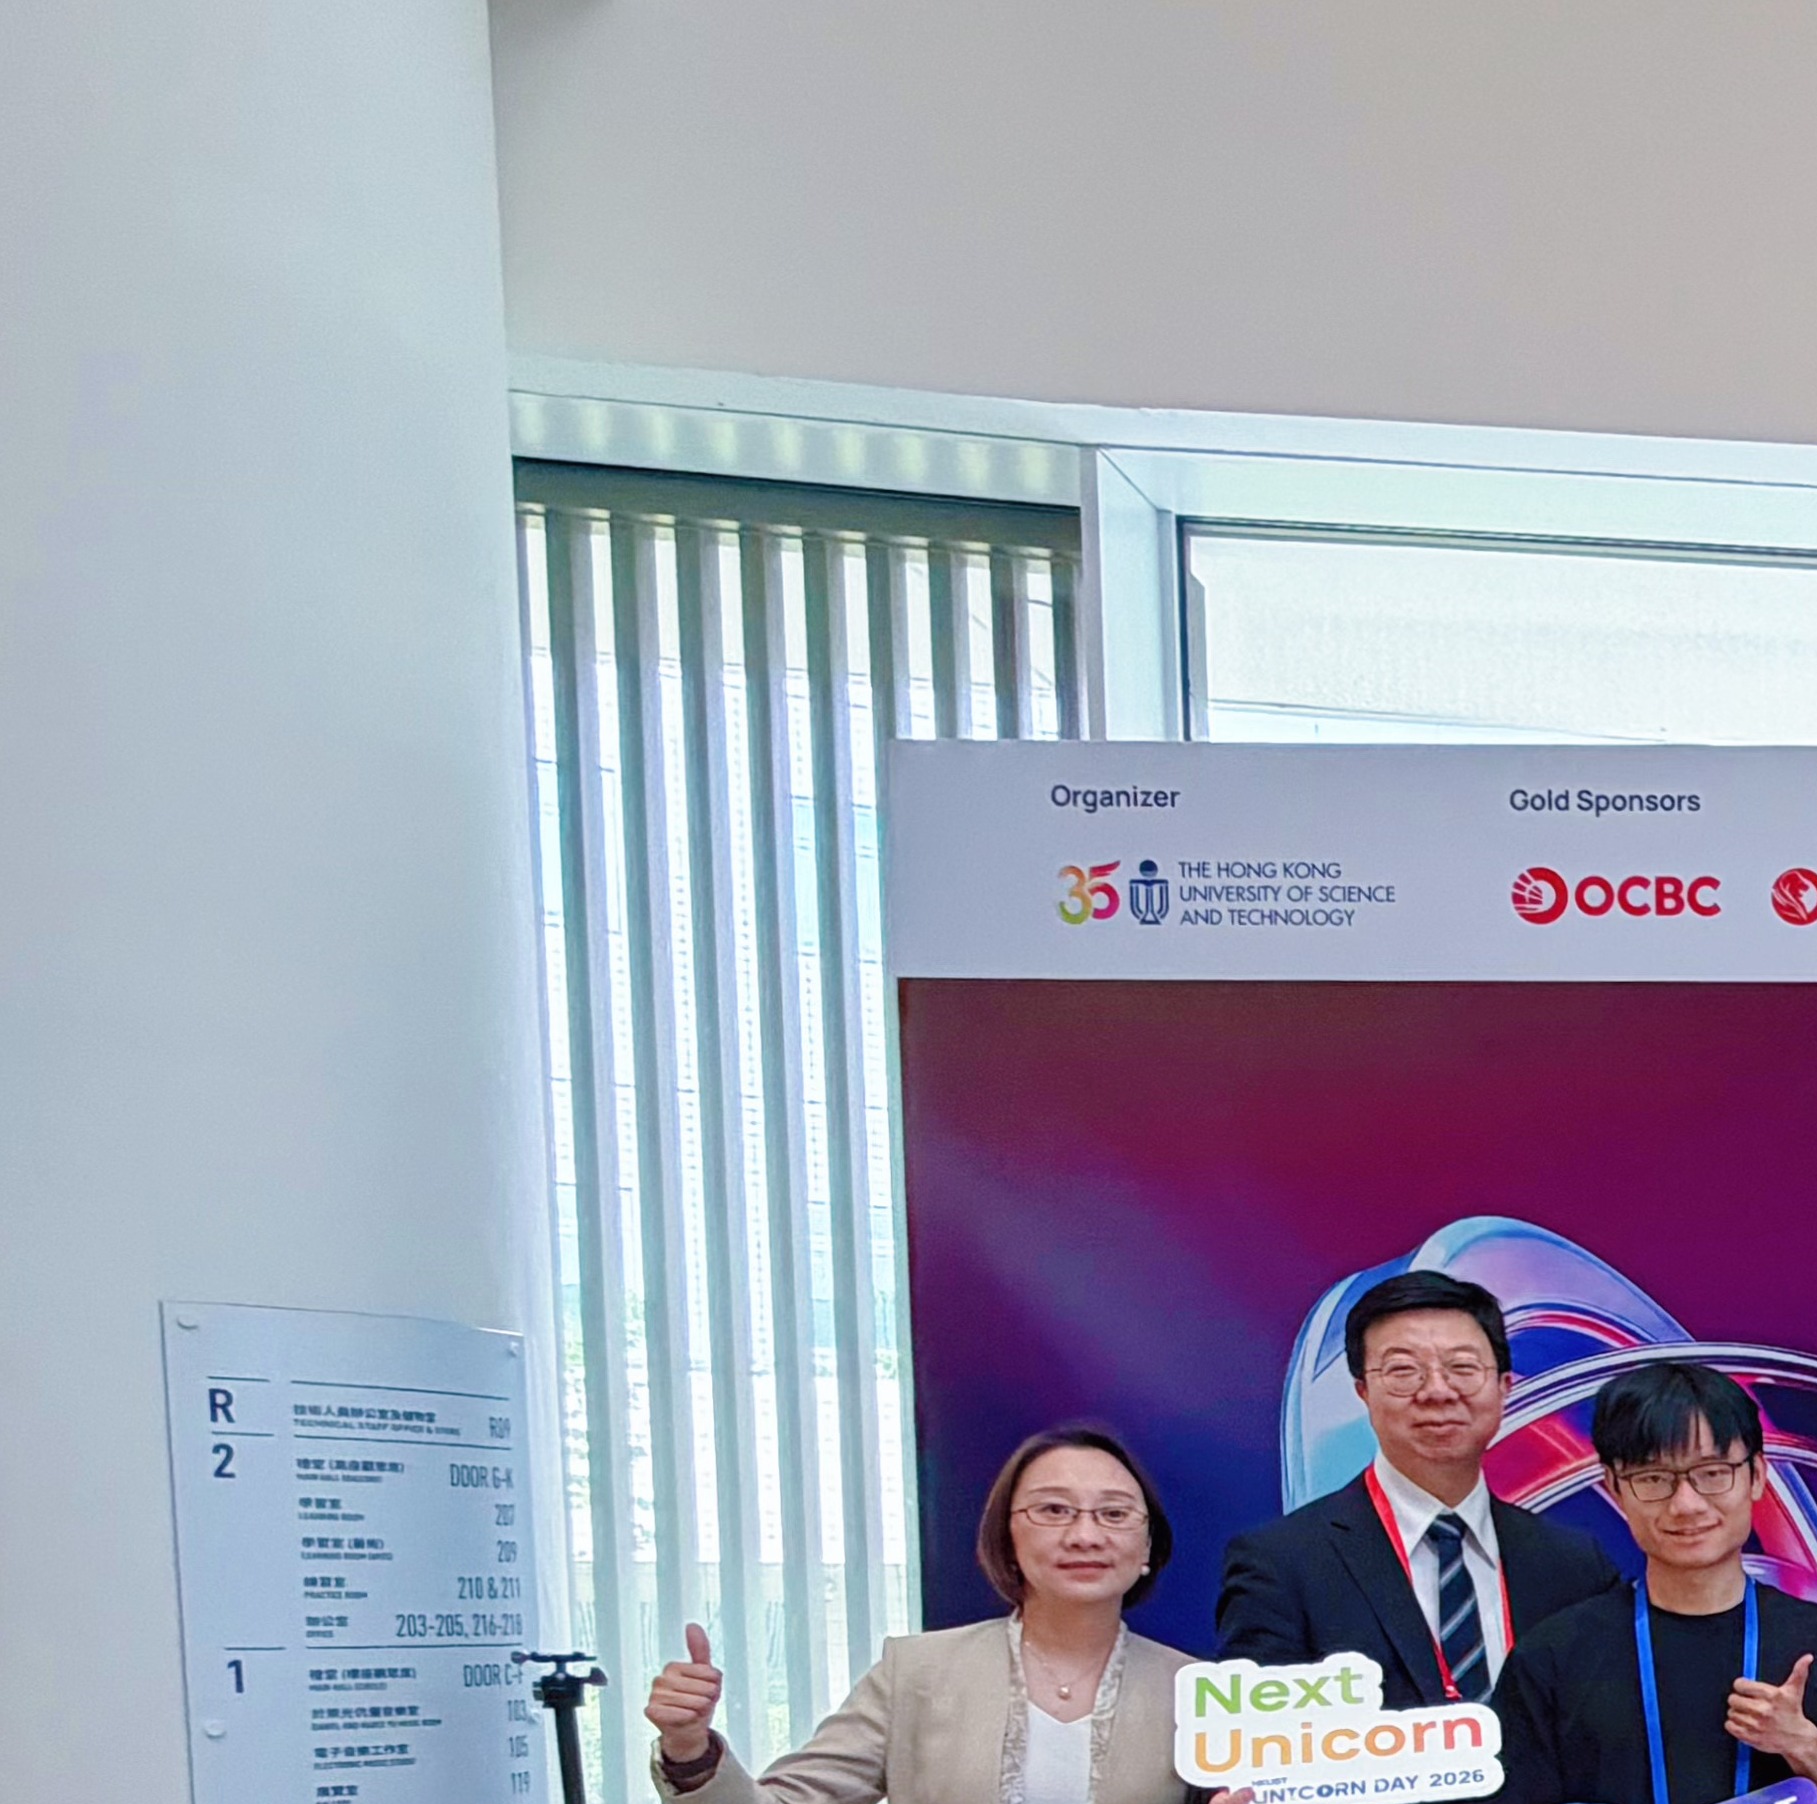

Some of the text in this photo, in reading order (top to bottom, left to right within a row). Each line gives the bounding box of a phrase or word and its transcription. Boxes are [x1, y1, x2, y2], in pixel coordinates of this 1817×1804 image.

[1051, 785, 1180, 812] Organizer
[1509, 788, 1701, 817] Gold Sponsors
[1179, 861, 1341, 879] THE HONG KONG
[1179, 885, 1396, 903] UNIVERSITY OF SCIENCE
[1575, 875, 1720, 917] OCBC
[1179, 909, 1356, 927] AND TECHNOLOGY
[208, 1387, 236, 1424] R
[212, 1443, 236, 1479] 2
[450, 1463, 488, 1488] DOOR
[458, 1577, 521, 1600] 210 211
[227, 1660, 244, 1693] 1
[463, 1664, 501, 1688] DOOR
[1196, 1665, 1364, 1717] Next
[1196, 1715, 1483, 1773] Unicorn
